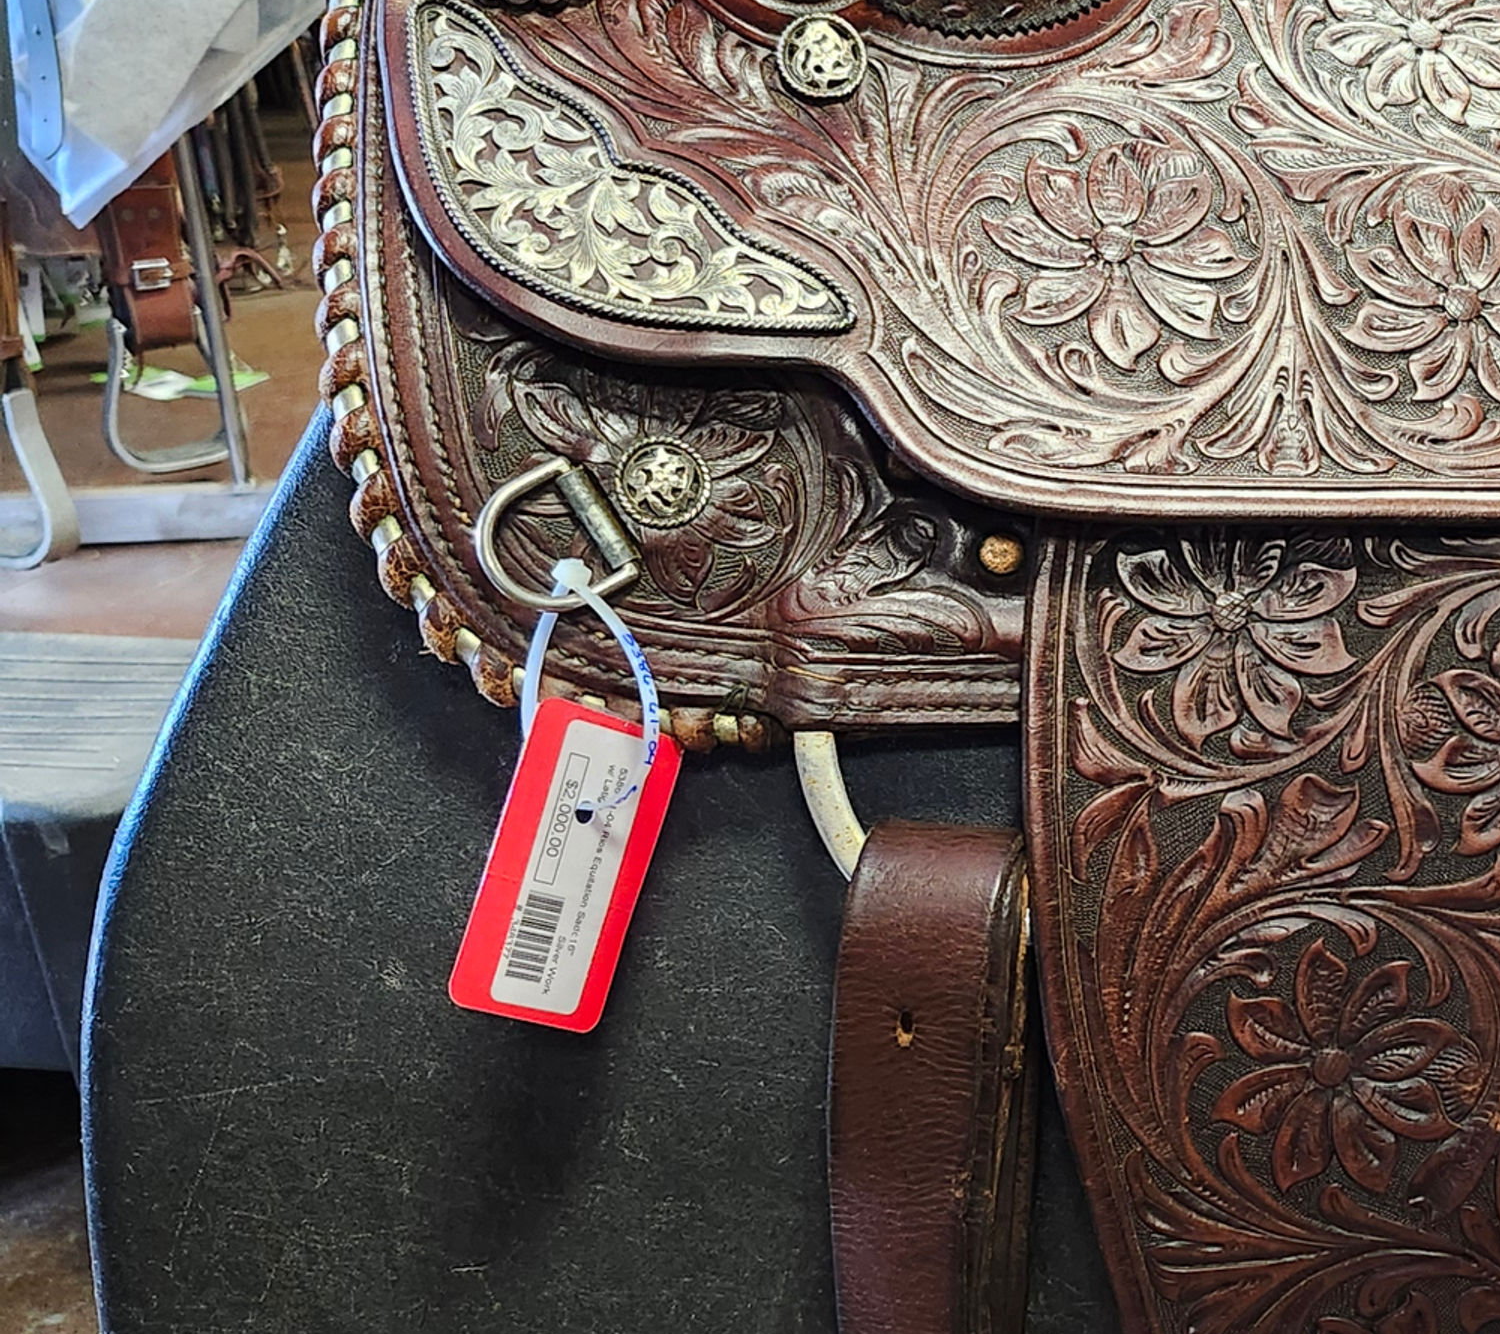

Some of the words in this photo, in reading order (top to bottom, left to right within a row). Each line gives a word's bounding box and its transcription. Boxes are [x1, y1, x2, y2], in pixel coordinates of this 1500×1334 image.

[544, 777, 579, 860] $2,000.00
[595, 830, 610, 855] Rios
[578, 855, 602, 909] Equitation
[550, 934, 566, 965] Silver
[540, 964, 558, 996] Work
